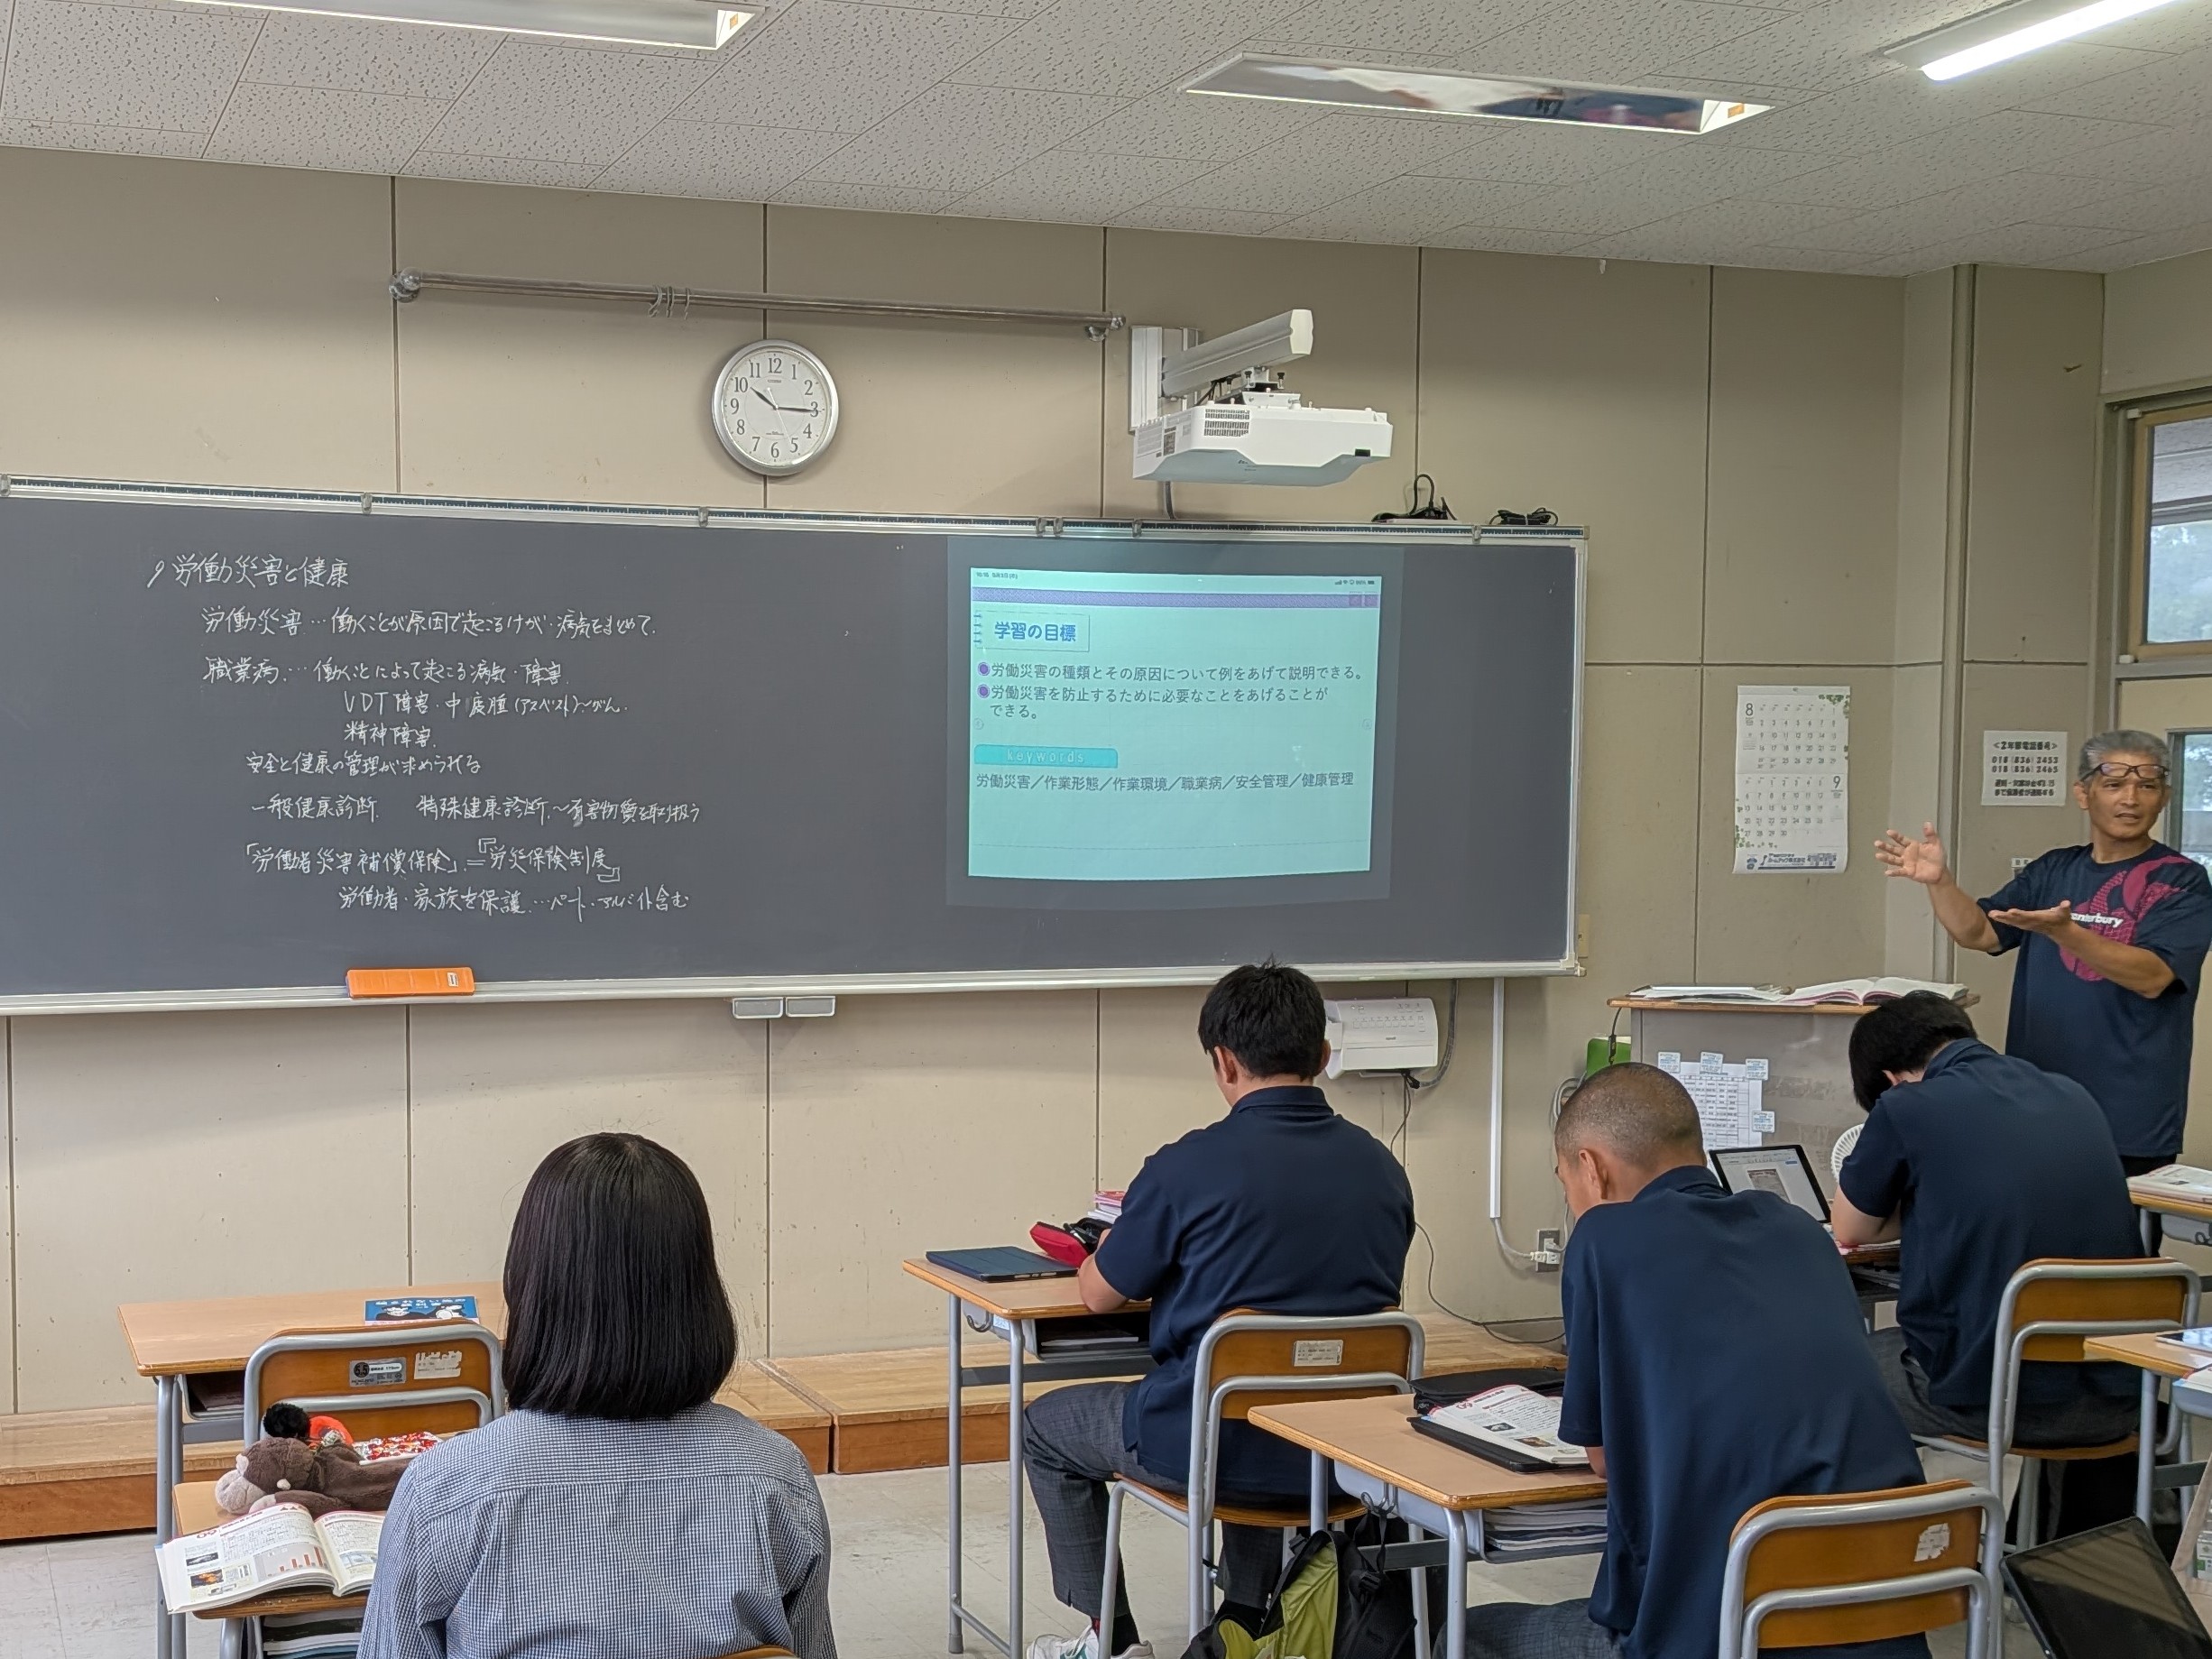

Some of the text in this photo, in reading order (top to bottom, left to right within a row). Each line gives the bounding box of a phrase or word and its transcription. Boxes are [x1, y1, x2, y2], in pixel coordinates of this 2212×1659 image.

[750, 362, 760, 378] 11
[768, 357, 782, 373] 12
[791, 364, 797, 380] 1
[733, 376, 748, 392] 10
[804, 380, 813, 396] 2
[730, 398, 739, 415] 9
[810, 401, 819, 417] 3
[736, 419, 745, 435] 8
[803, 423, 812, 438] 4
[751, 437, 760, 452] 7
[770, 442, 779, 458] 6
[789, 437, 798, 453] 5
[994, 621, 1076, 642] 学習の目標
[991, 663, 1361, 681] 労働災害の種類とその原因について例をあげて説明できる。
[991, 686, 1328, 703] 労働災害を防止するために必要なことをあげることが
[991, 705, 1037, 719] できる。
[1746, 703, 1753, 716] 8
[1833, 776, 1840, 788] 9
[2070, 913, 2124, 927] anterbury
